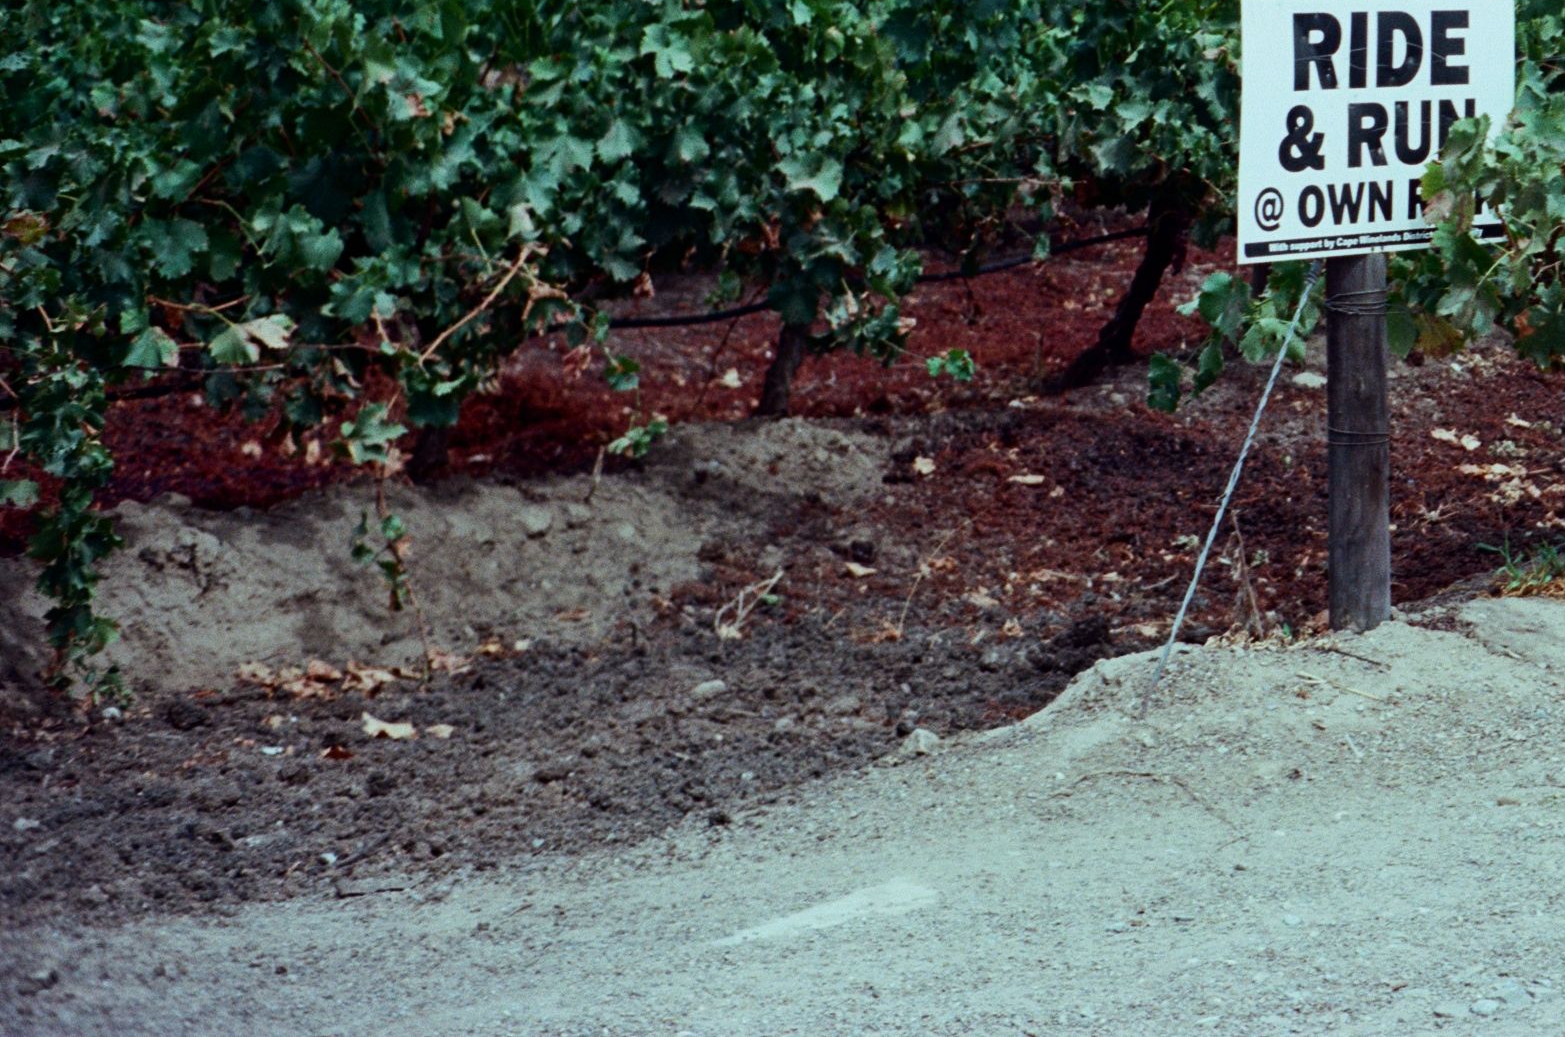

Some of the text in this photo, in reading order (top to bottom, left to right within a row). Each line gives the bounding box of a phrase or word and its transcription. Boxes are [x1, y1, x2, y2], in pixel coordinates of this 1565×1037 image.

[1292, 9, 1470, 92] RIDE
[1278, 104, 1325, 173] &
[1254, 187, 1284, 232] @
[1297, 179, 1393, 228] OWN
[1290, 239, 1323, 253] support
[1324, 238, 1336, 250] by
[1336, 236, 1359, 249] Cape
[1359, 232, 1402, 246] Winelands
